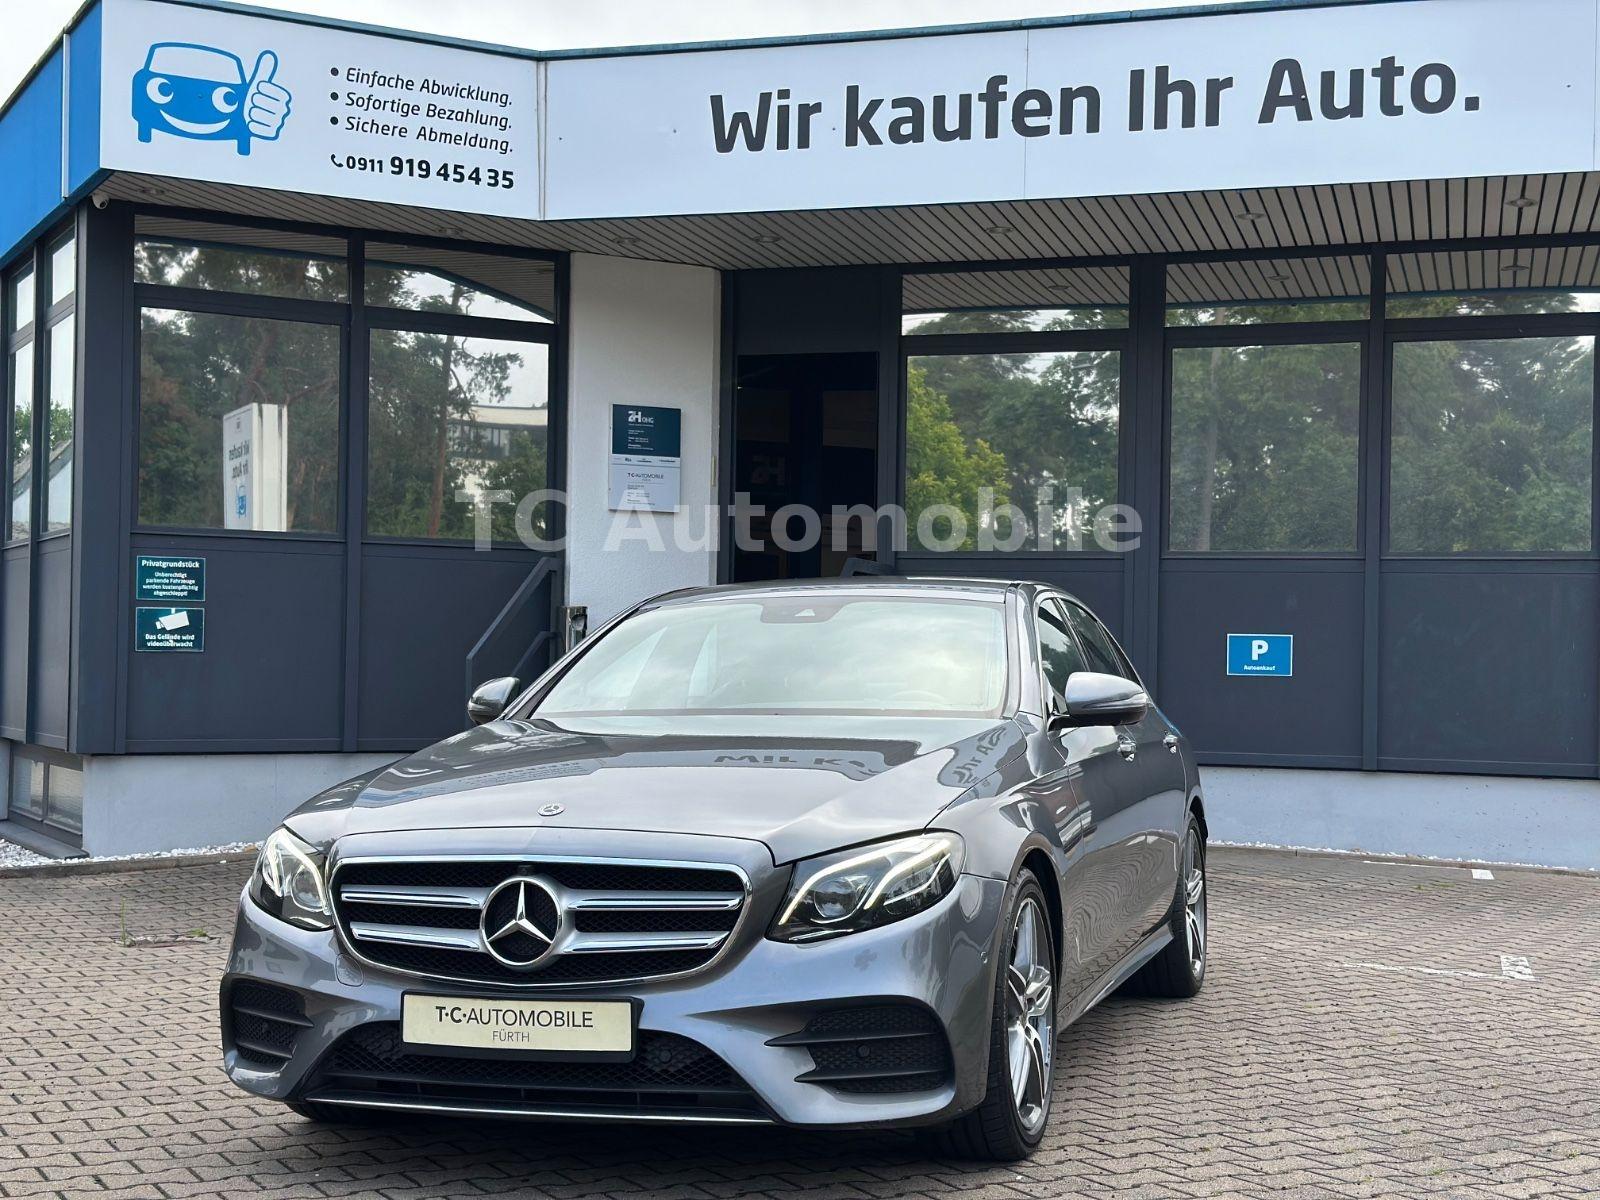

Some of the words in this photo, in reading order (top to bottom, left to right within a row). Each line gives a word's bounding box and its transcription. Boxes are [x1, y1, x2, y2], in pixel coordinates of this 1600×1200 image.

[346, 67, 415, 91] Einfache
[419, 78, 512, 108] Abwicklung.
[709, 88, 823, 154] Wir
[845, 74, 1101, 148] kaufen
[1128, 65, 1234, 132] Ihr
[1257, 55, 1480, 124] Auto.
[345, 91, 421, 118] Sofortige
[425, 102, 512, 132] Bezahlung.
[344, 116, 408, 138] Sichere
[415, 125, 513, 155] Abmeldung.
[345, 155, 384, 174] 0911
[389, 155, 431, 179] 919
[435, 162, 482, 186] 454
[486, 168, 515, 190] 35
[141, 559, 200, 569] Privatgrundstück
[146, 640, 193, 648] videoüberwacht
[1252, 640, 1268, 661] P
[492, 1029, 530, 1043] FÜRTH
